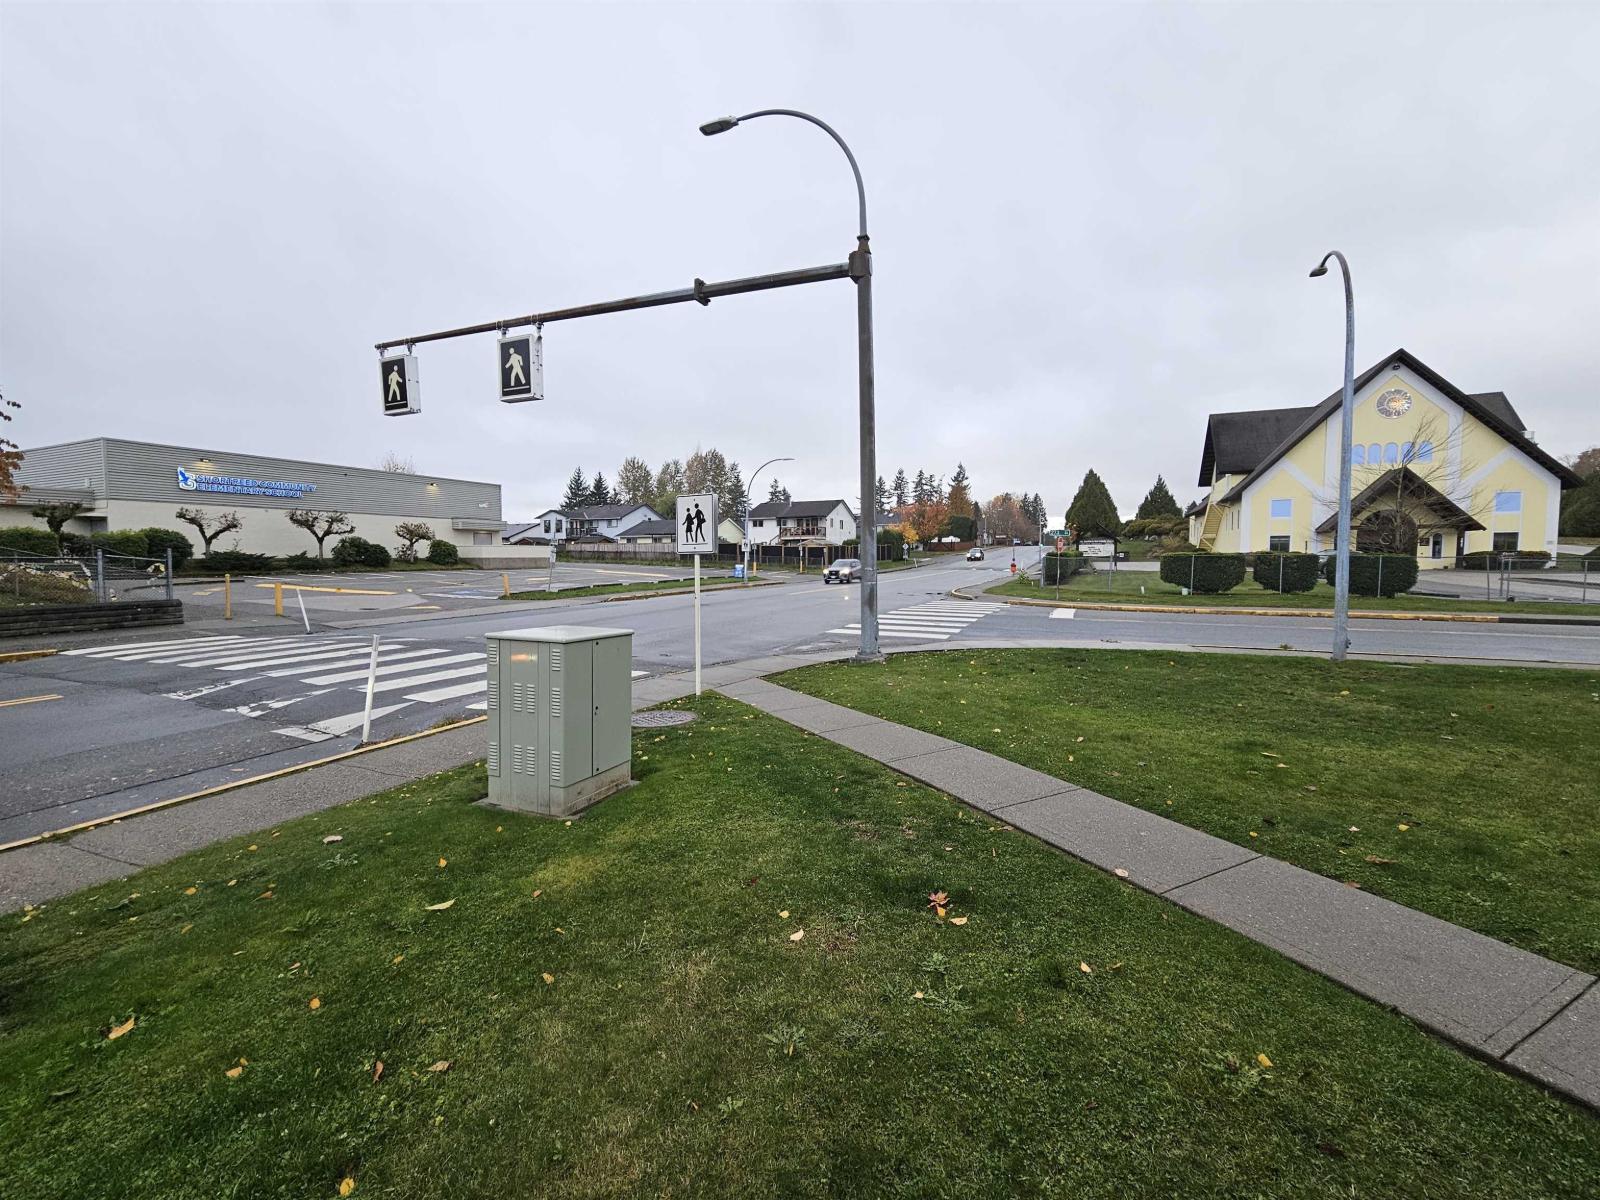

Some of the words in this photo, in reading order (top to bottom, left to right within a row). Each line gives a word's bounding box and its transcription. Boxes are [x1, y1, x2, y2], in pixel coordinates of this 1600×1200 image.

[197, 483, 264, 495] ELEMENTARY
[264, 488, 303, 498] SCHOOL
[259, 481, 317, 491] COMMUNITY
